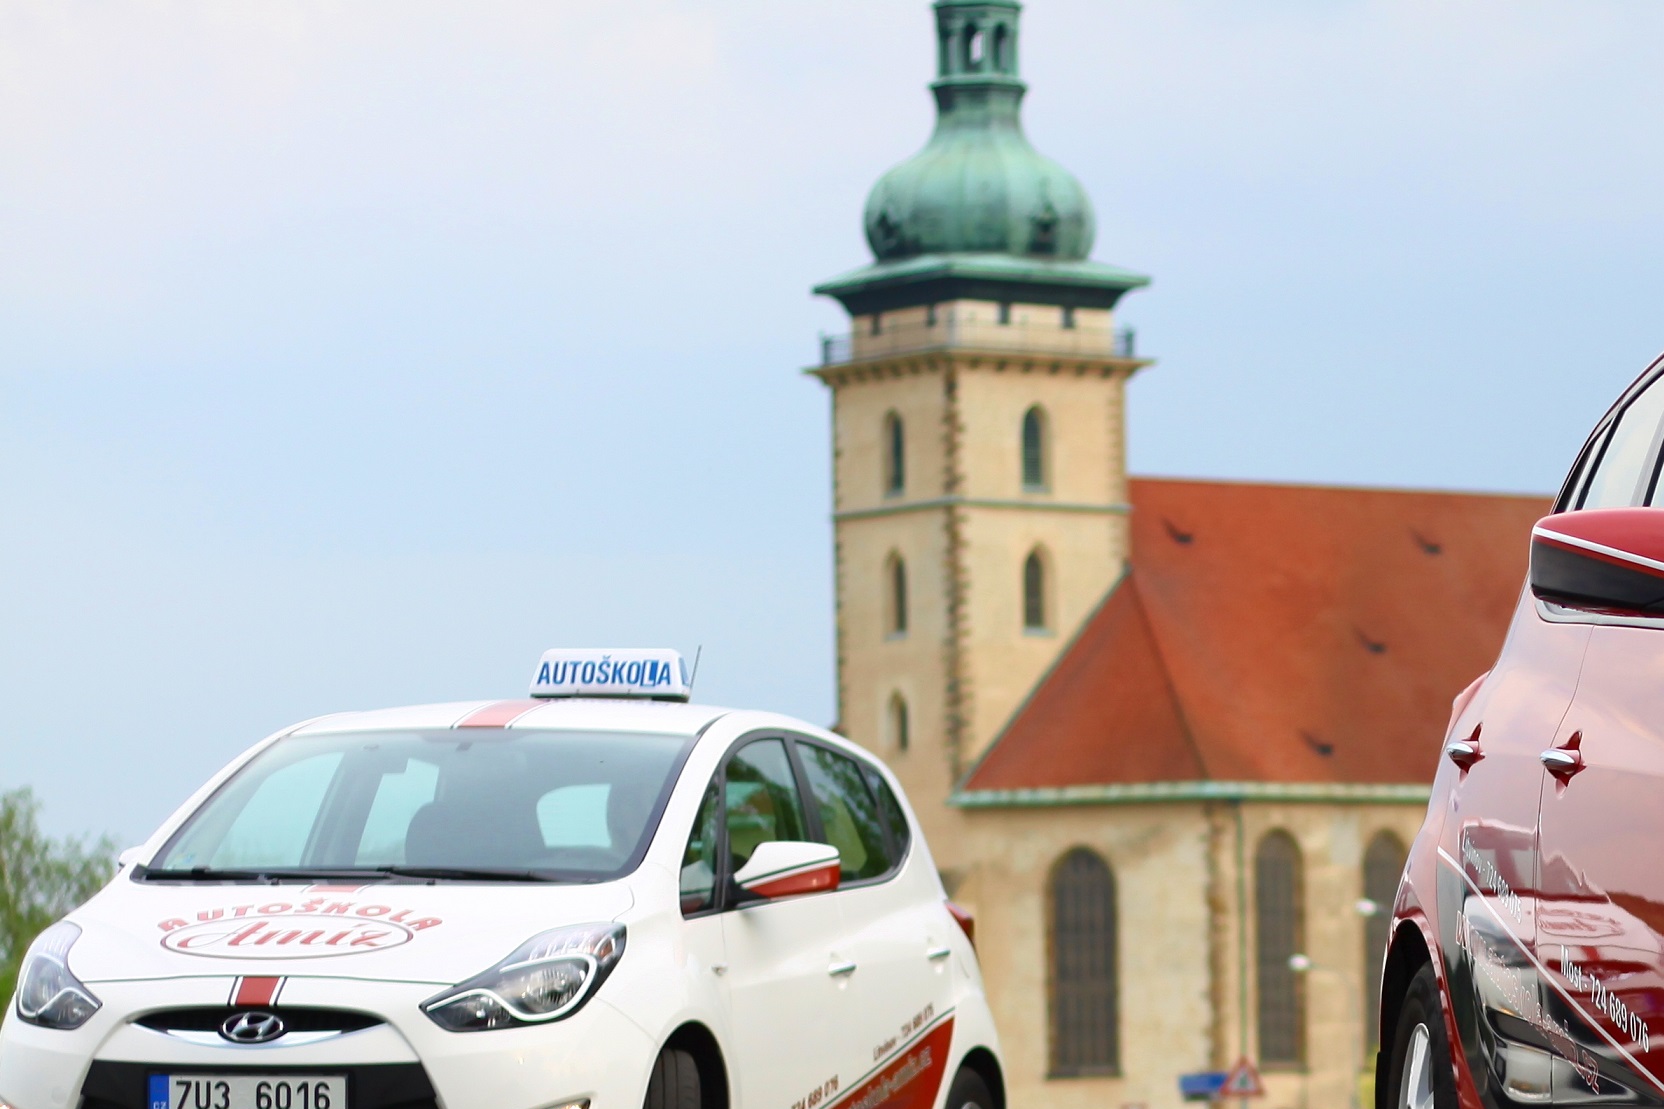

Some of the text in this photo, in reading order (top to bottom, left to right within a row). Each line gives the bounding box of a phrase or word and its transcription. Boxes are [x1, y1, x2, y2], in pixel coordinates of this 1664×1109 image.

[537, 655, 671, 687] AUTOŠKOLA
[157, 897, 443, 932] AUTOŠKOLA
[1561, 945, 1582, 992] Most
[1590, 973, 1607, 1014] 724
[1609, 991, 1628, 1034] 689
[1630, 1011, 1649, 1053] 076
